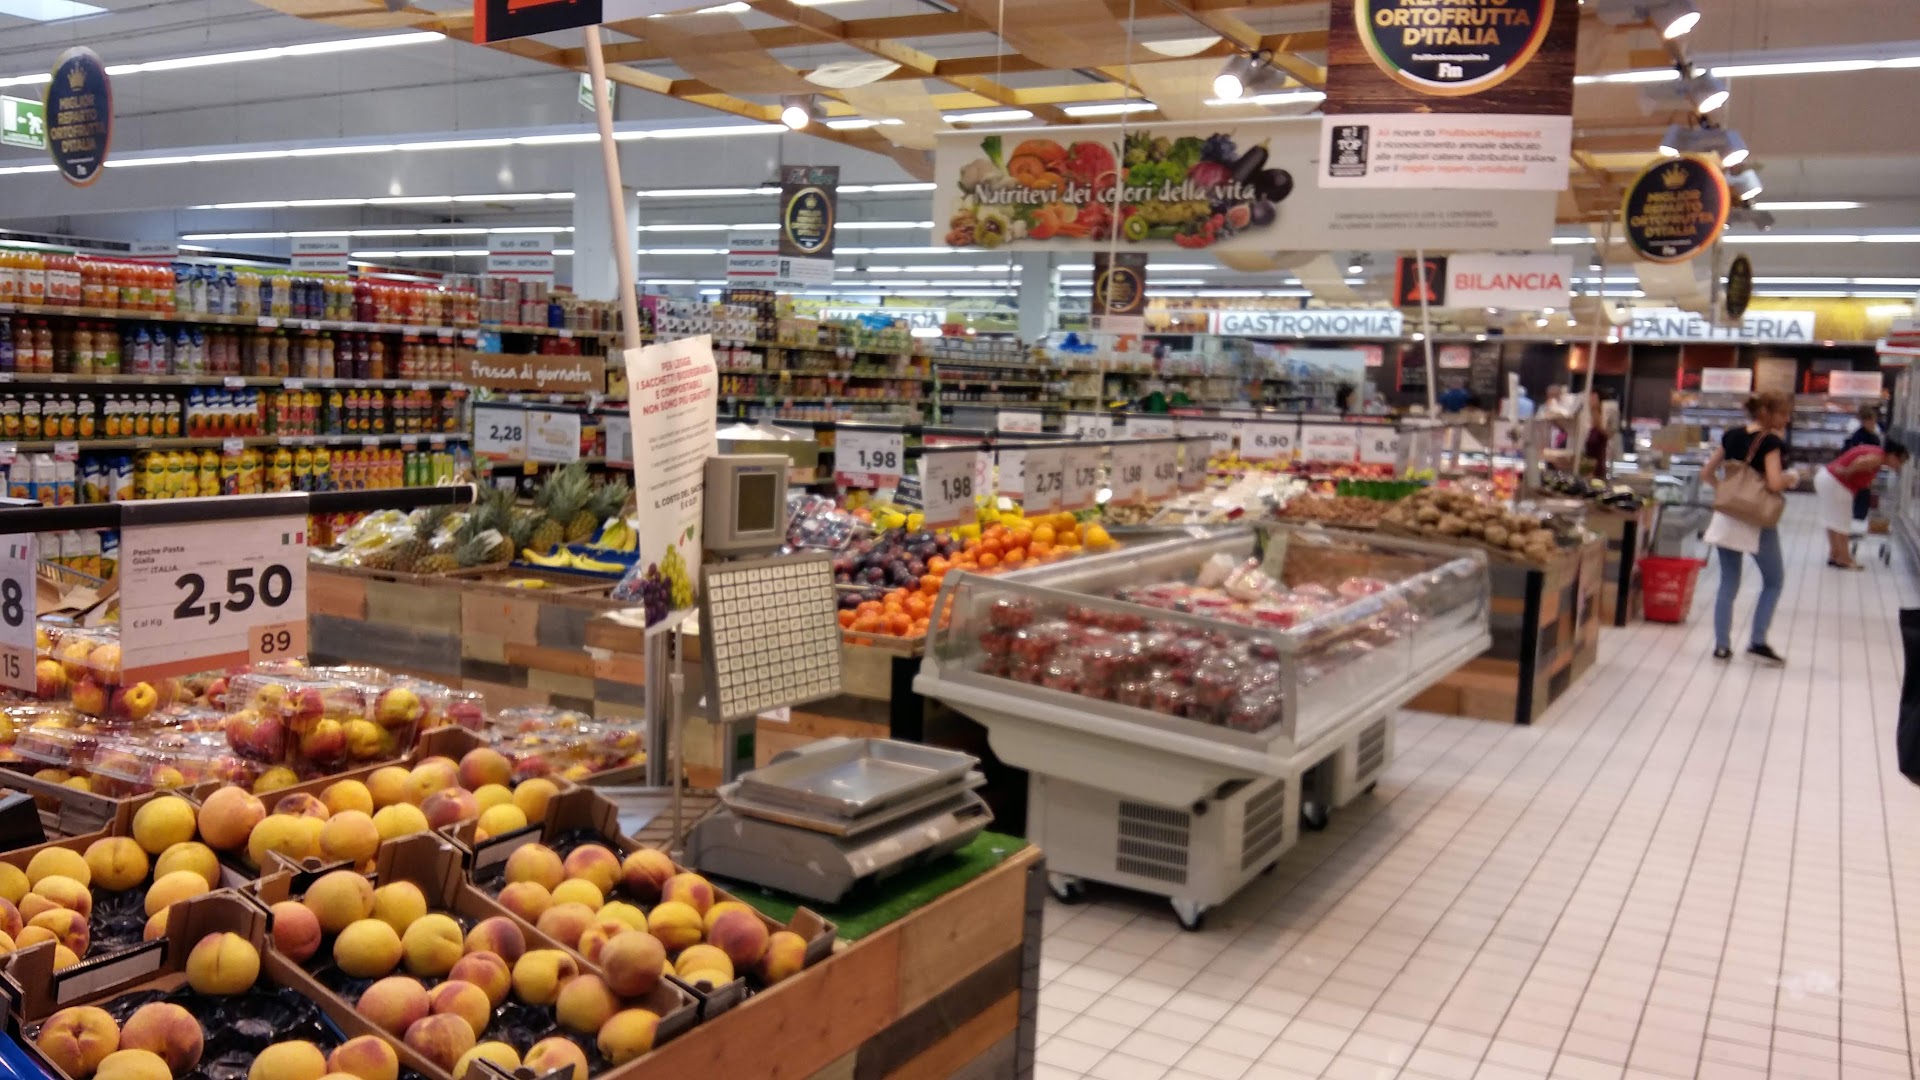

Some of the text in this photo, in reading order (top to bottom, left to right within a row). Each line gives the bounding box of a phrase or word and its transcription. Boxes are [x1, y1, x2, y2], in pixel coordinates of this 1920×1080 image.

[1375, 8, 1531, 27] ORTOFRUTTA
[1402, 27, 1500, 46] D'ITALIA
[974, 179, 1256, 204] Nutritevi dei colori della vita
[1630, 211, 1715, 228] ORTOFRUTTA
[1455, 272, 1563, 291] BILANCIA
[1223, 314, 1395, 335] GASTRONOMIA
[471, 360, 592, 387] fresca di giornata
[643, 404, 659, 416] NON
[660, 399, 678, 411] SONO
[490, 425, 523, 443] 2,28
[1255, 435, 1289, 448] 6,90
[858, 450, 896, 470] 1,98
[941, 475, 972, 504] 1,98
[1036, 471, 1062, 496] 2,75
[132, 548, 160, 556] Pesche
[150, 565, 179, 574] ITALIA
[173, 564, 293, 626] 2,50
[133, 618, 163, 628] € al Kg
[260, 630, 291, 655] 89
[2, 652, 20, 679] 15
